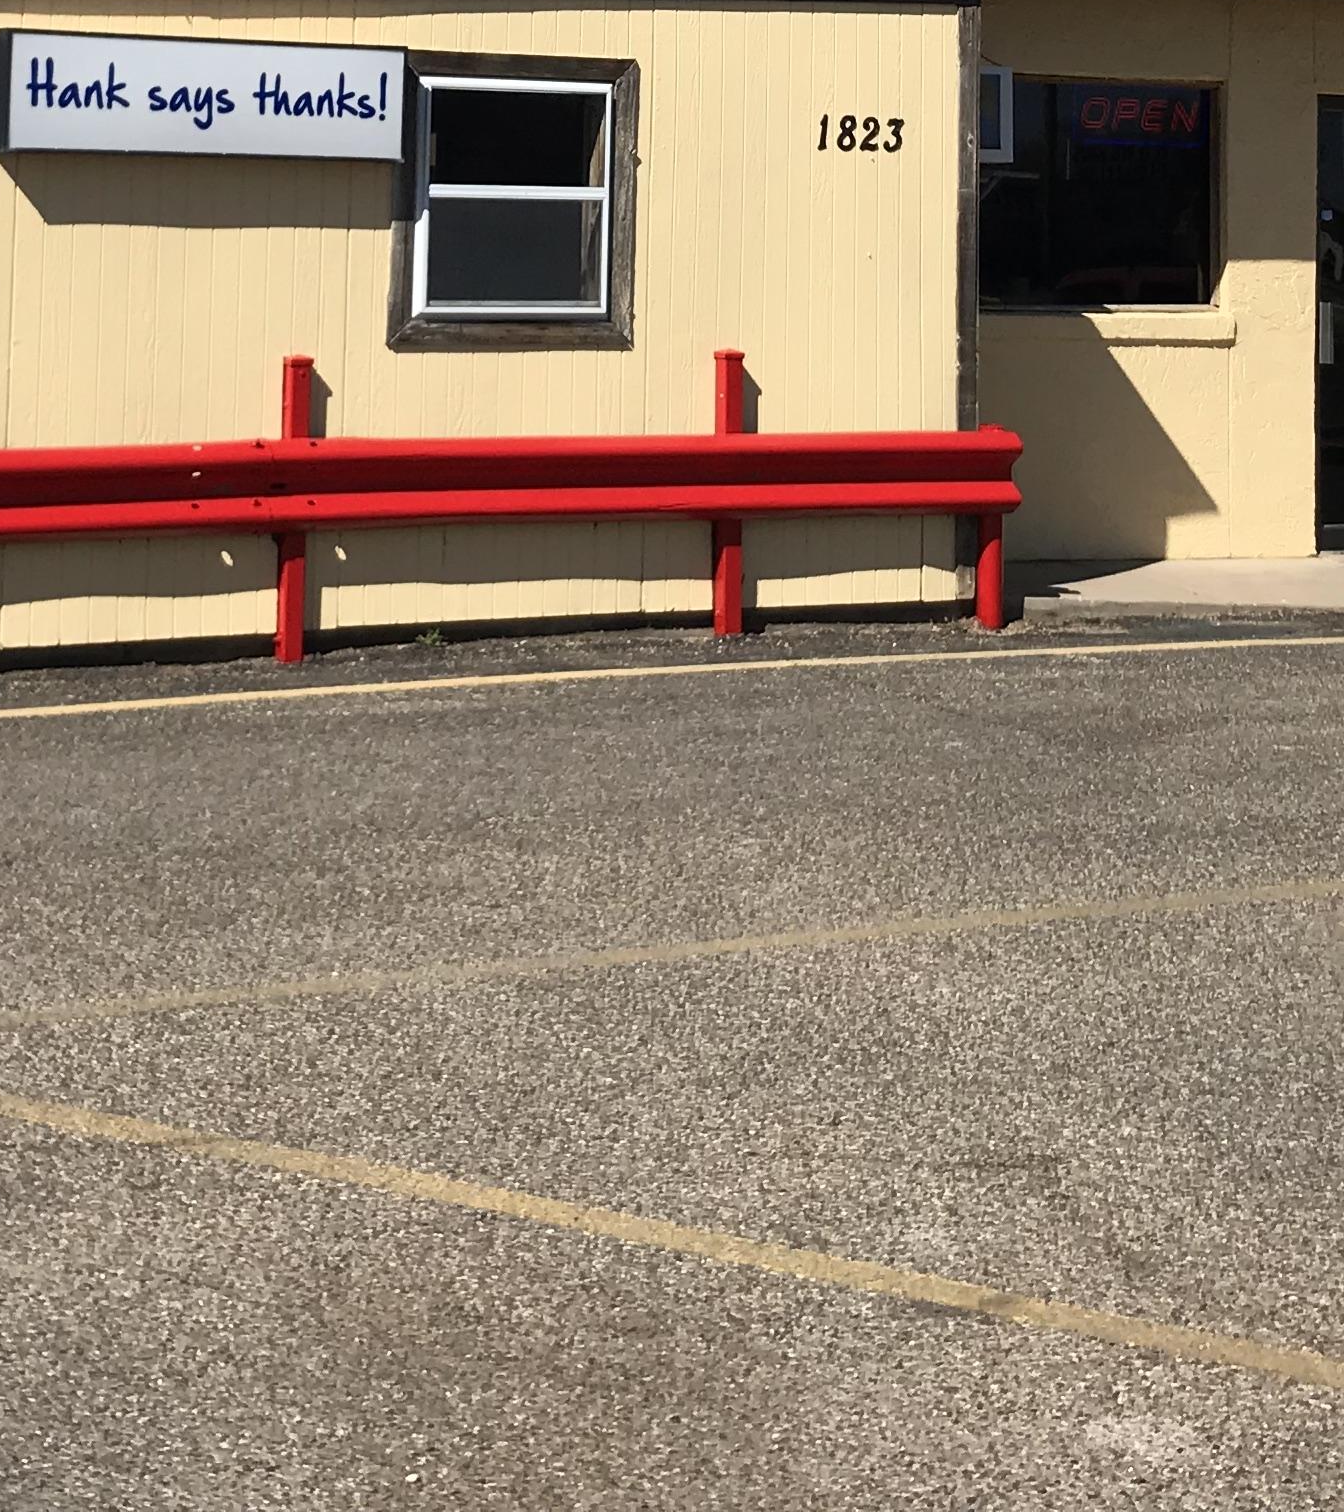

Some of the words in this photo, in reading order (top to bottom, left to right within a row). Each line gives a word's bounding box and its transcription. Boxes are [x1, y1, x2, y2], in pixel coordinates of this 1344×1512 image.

[27, 57, 130, 108] Hank
[149, 85, 236, 130] says
[253, 71, 388, 121] thanks!
[817, 113, 905, 153] 1823
[1080, 95, 1200, 137] OPEN
